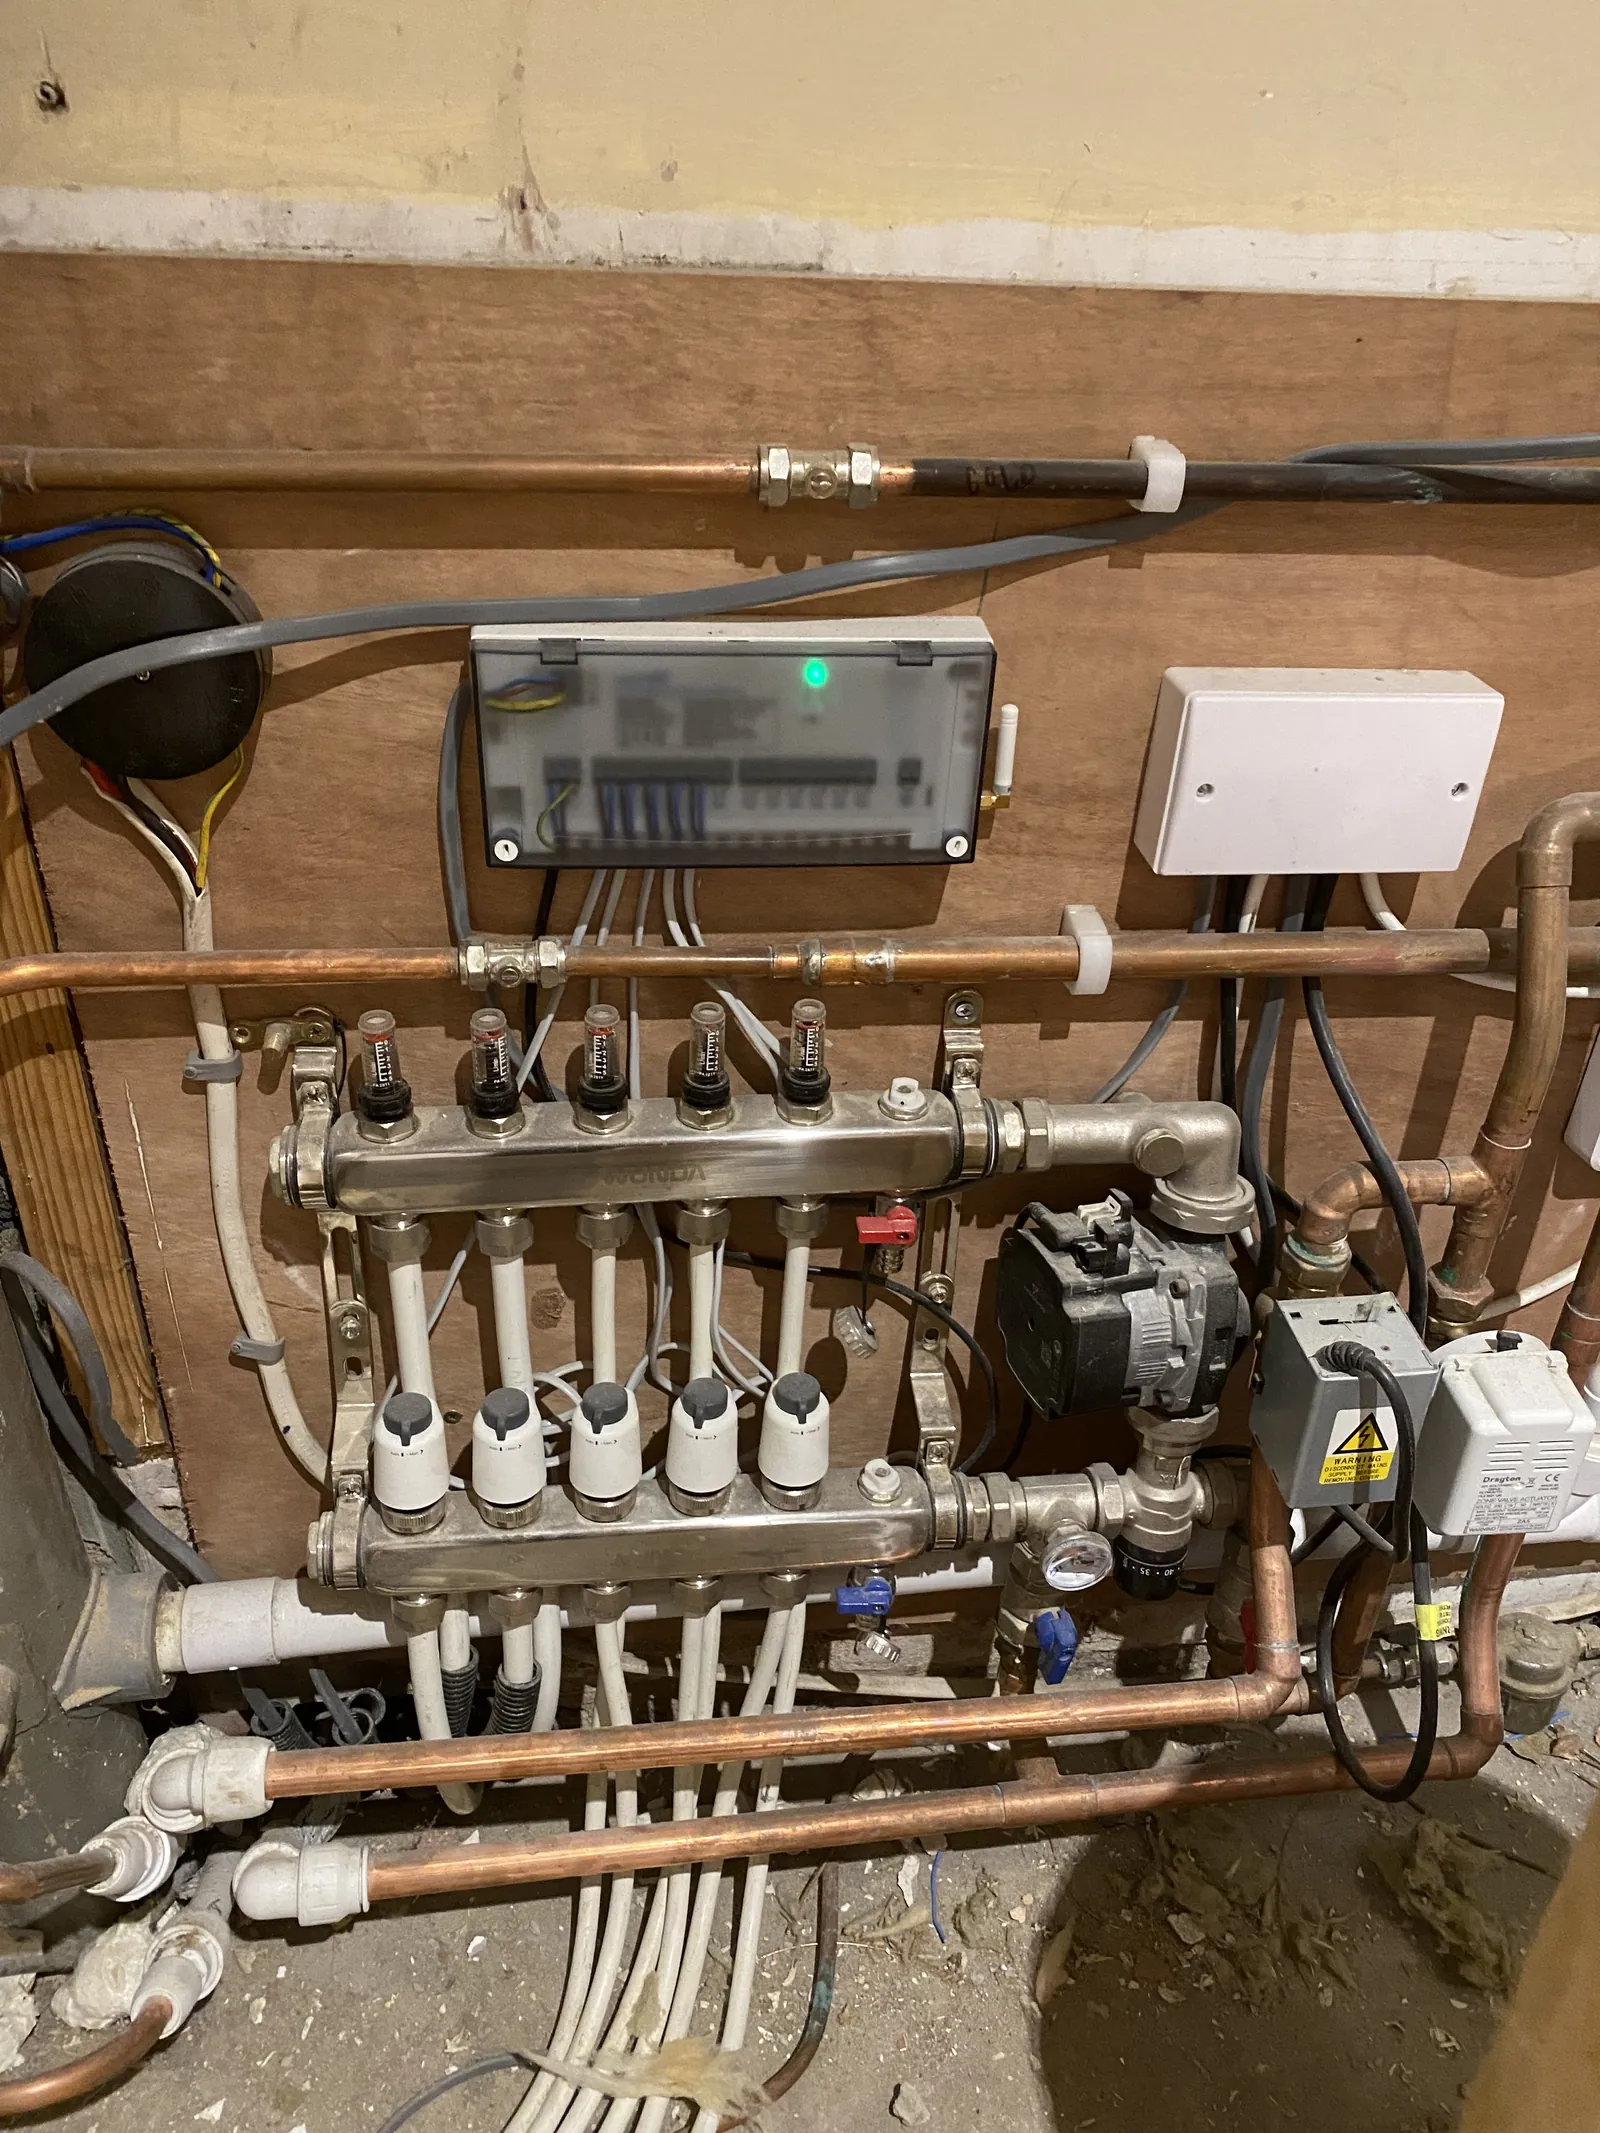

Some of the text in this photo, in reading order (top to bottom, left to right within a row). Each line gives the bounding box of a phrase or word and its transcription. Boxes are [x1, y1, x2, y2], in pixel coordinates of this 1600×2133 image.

[964, 463, 1036, 494] COLD
[1334, 1455, 1382, 1465] WARNING
[1324, 1464, 1364, 1472] DISCONNECT
[1139, 1567, 1151, 1576] 35
